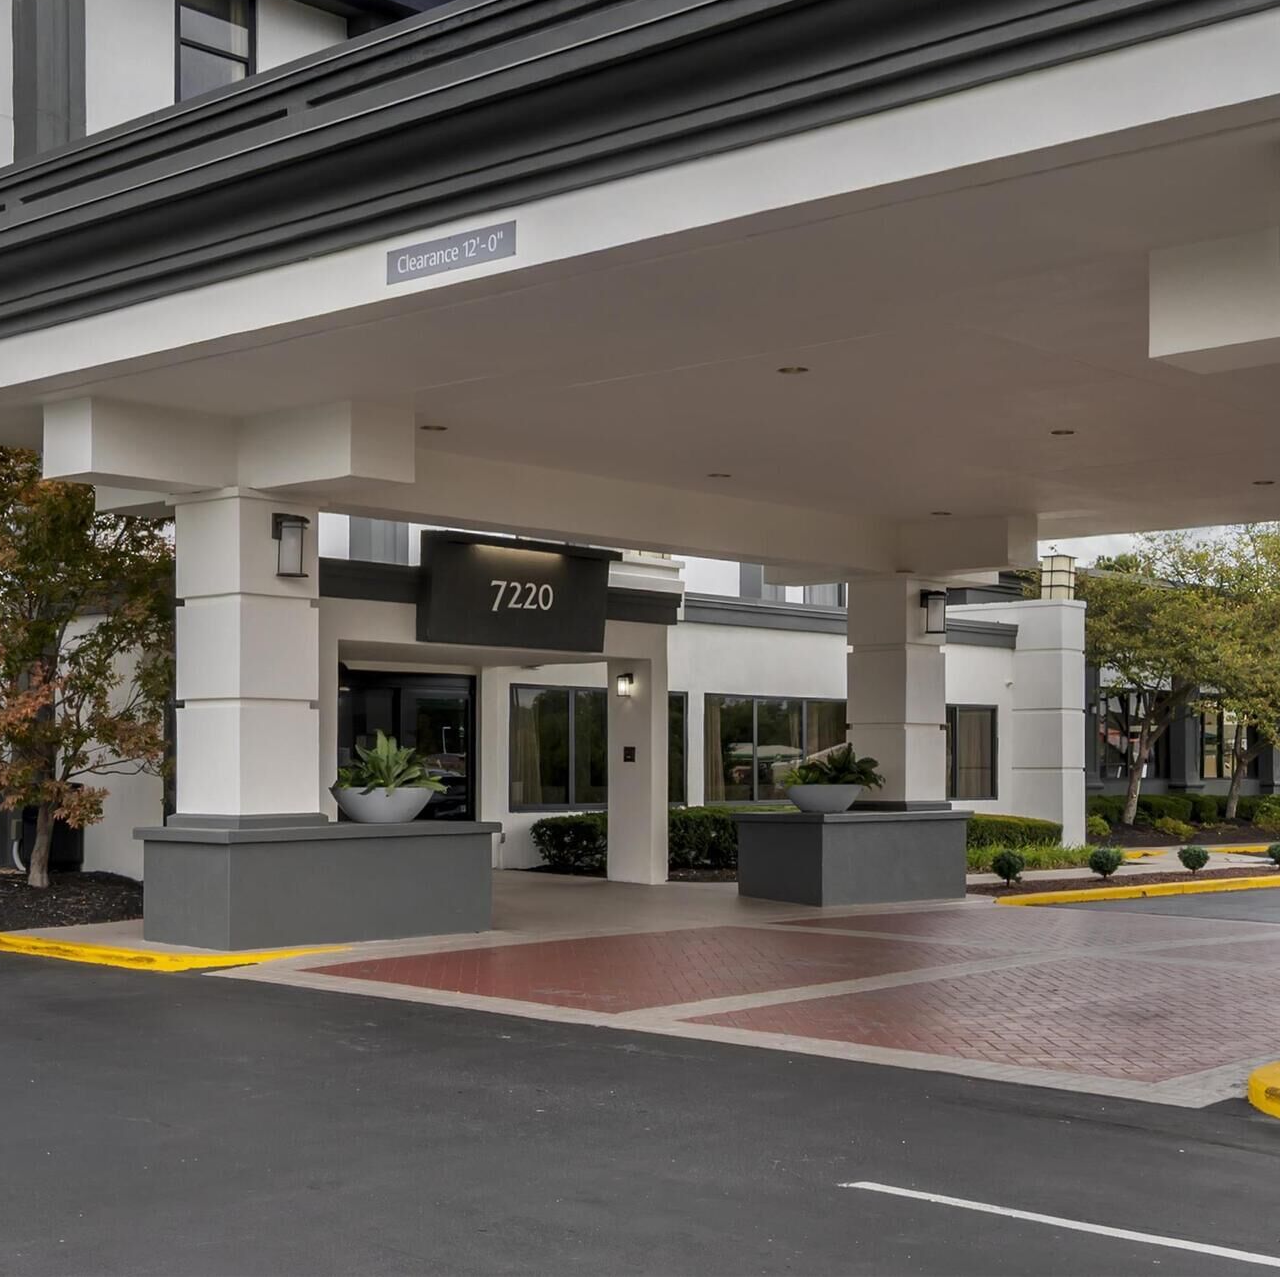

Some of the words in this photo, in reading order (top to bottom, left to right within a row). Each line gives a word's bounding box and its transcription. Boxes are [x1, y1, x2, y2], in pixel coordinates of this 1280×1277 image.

[397, 246, 459, 274] Clearance
[463, 231, 504, 258] 12'-0"
[490, 579, 554, 612] 7220
